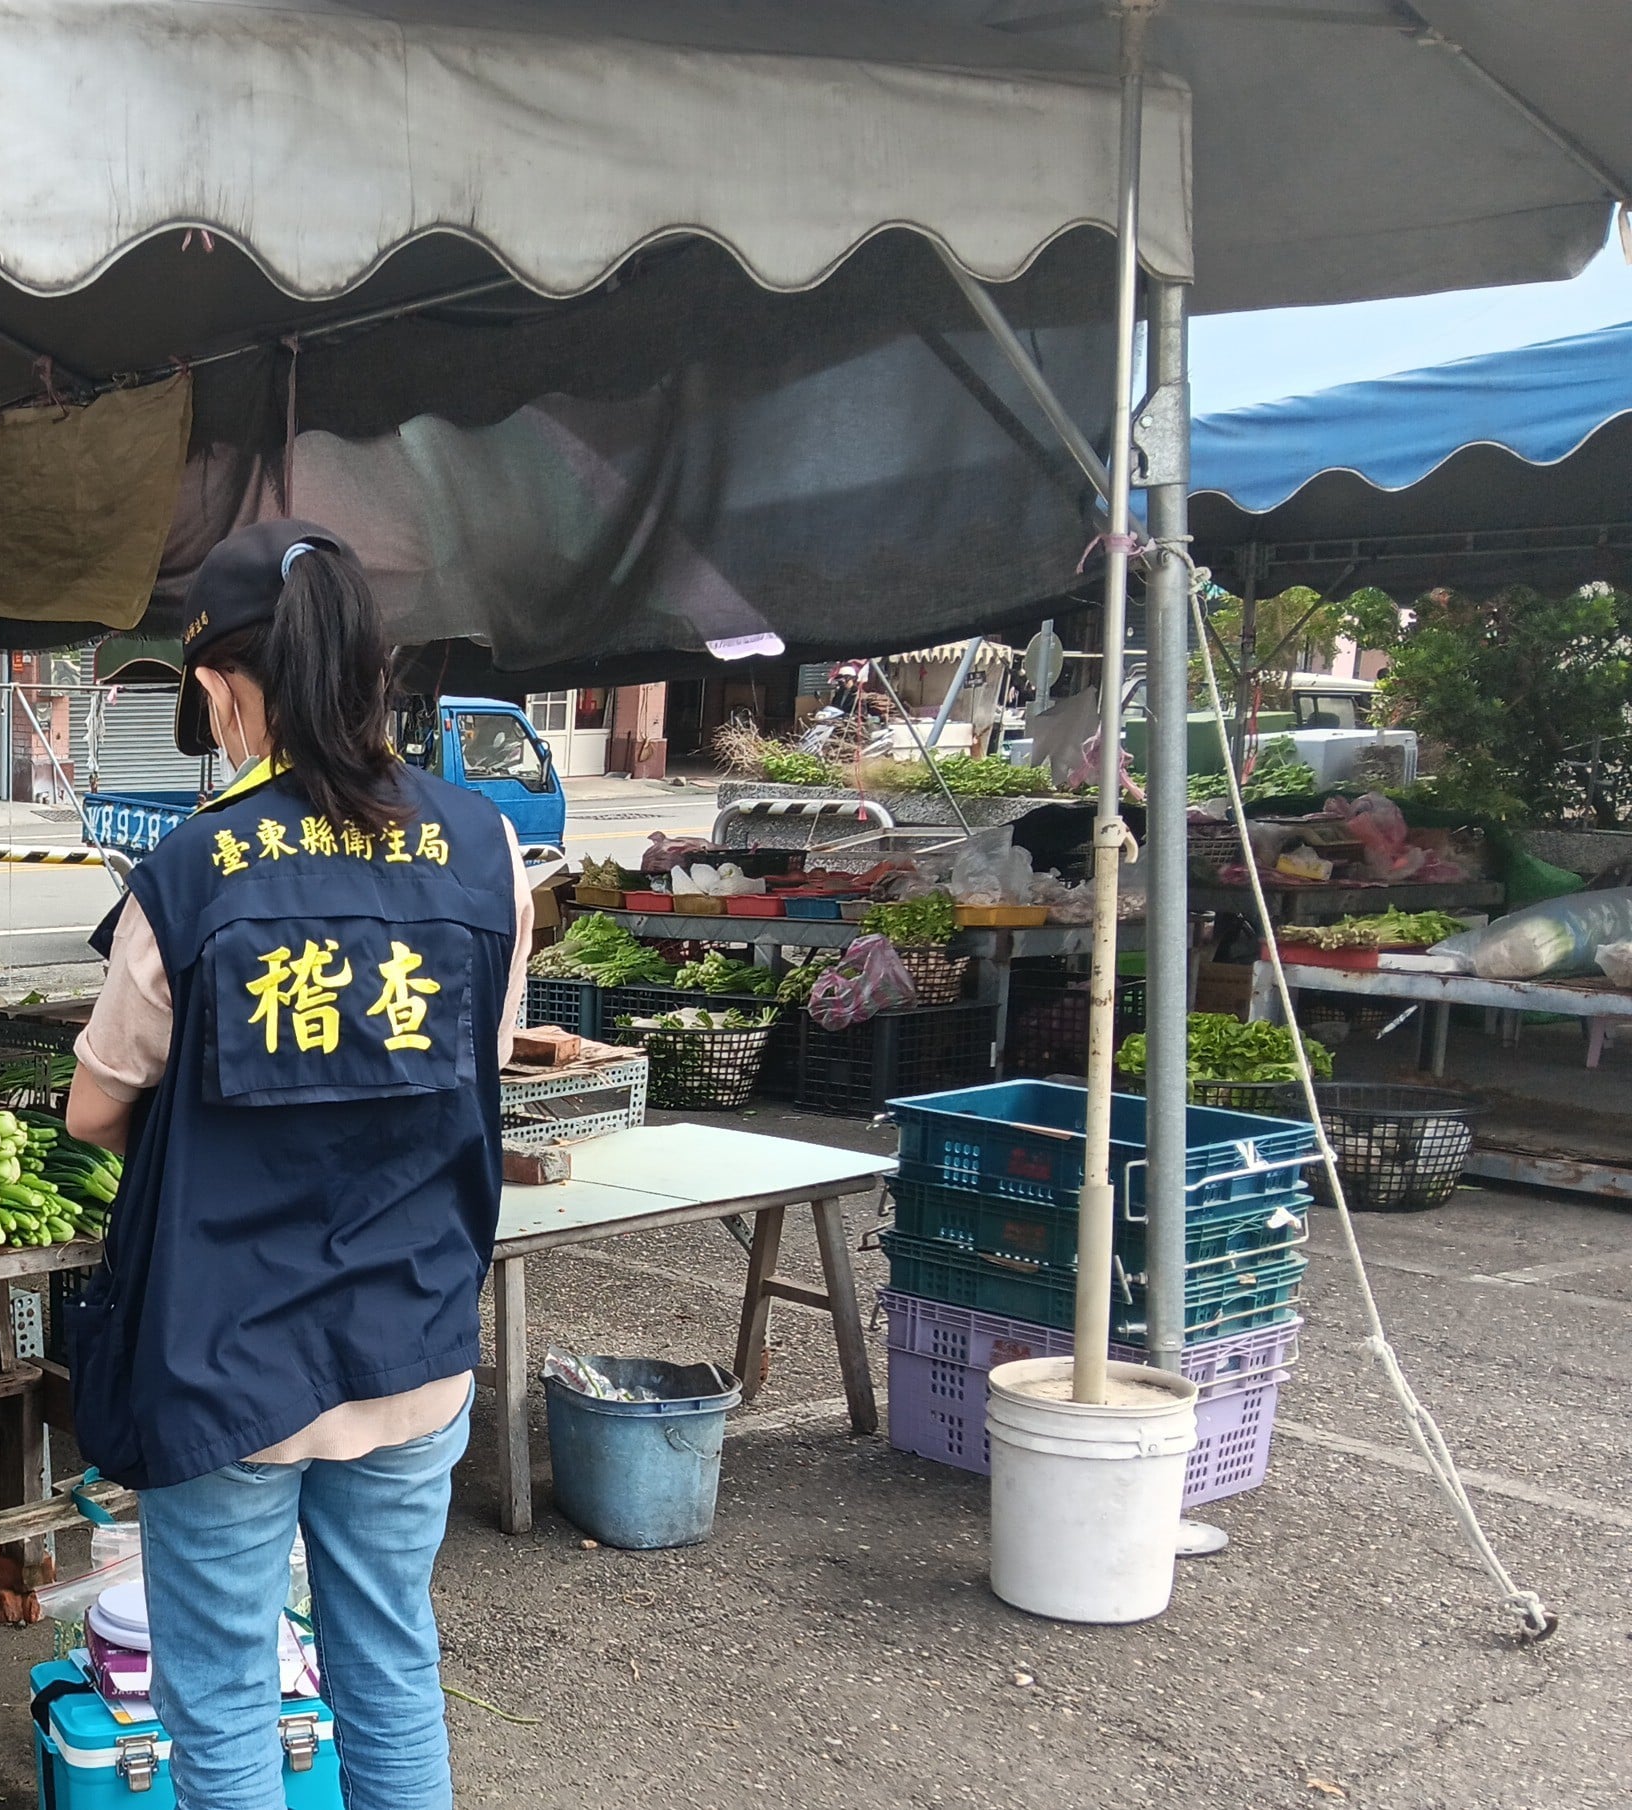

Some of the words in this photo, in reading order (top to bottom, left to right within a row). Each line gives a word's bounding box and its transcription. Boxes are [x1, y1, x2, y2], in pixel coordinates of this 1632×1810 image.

[211, 815, 450, 876] 臺東縣衛生局
[245, 940, 441, 1055] 稽查
